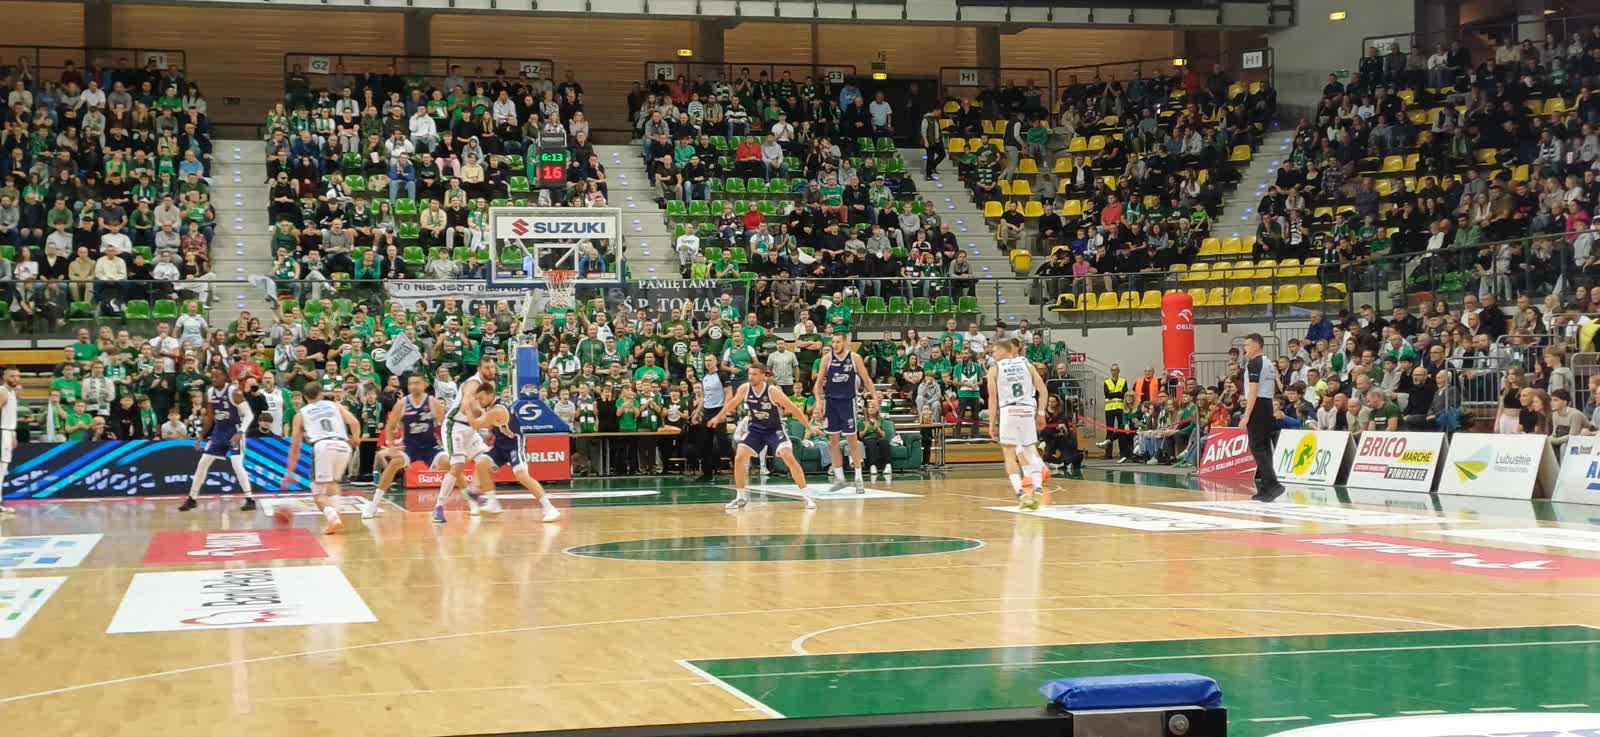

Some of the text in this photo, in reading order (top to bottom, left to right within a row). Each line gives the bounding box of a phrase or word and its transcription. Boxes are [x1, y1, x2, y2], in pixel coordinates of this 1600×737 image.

[312, 60, 329, 70] G2
[1245, 55, 1261, 65] H1
[523, 65, 540, 74] G2
[962, 73, 975, 81] H1
[542, 153, 563, 162] 6:13
[543, 166, 562, 179] 16
[534, 222, 606, 234] SUZUKI
[395, 283, 410, 291] TO
[639, 279, 717, 291] PAMIĘTAMY
[657, 297, 721, 312] TOMAS
[1011, 383, 1024, 397] 8
[1359, 437, 1407, 458] BRICO
[418, 474, 441, 483] Bank
[1388, 468, 1427, 480] POMORSKIE
